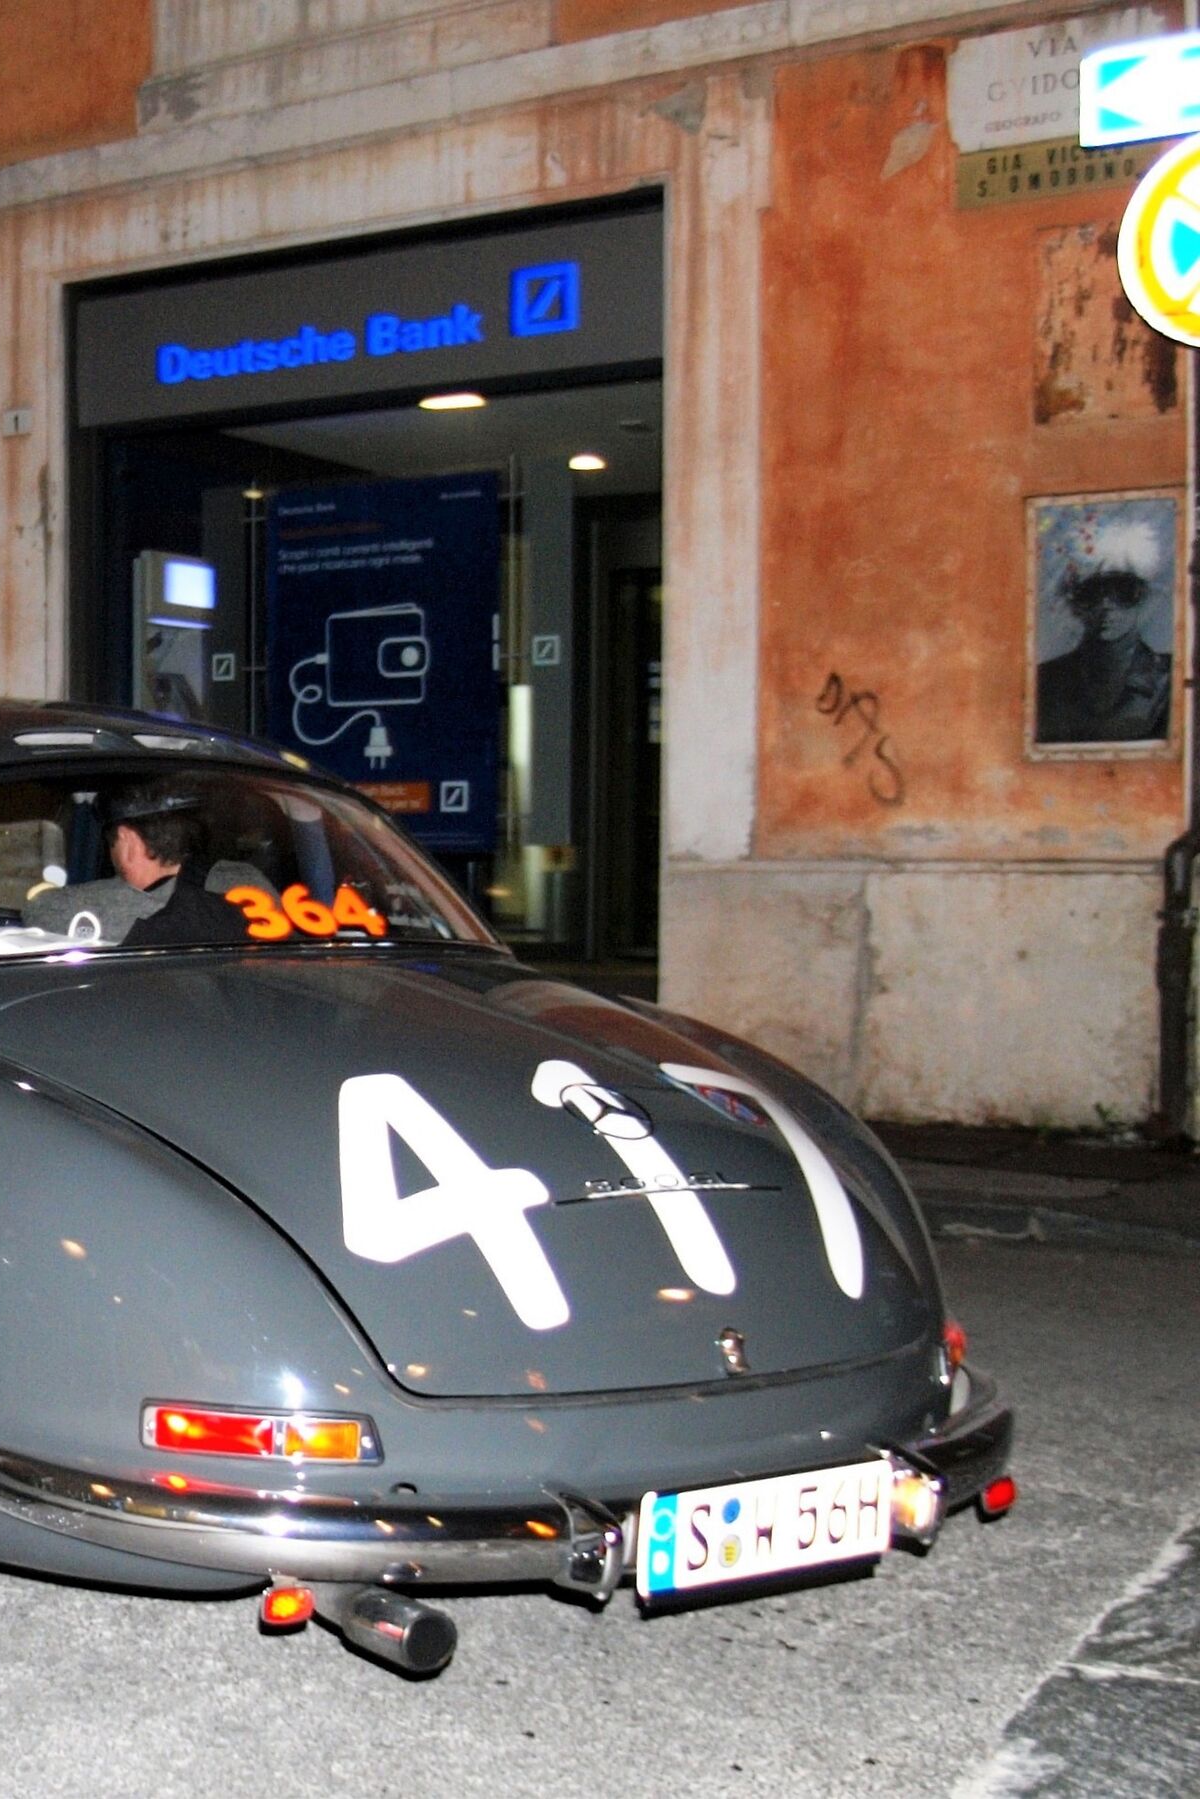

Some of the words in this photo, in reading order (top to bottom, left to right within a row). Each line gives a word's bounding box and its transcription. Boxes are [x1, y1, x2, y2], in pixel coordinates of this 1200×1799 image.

[1027, 36, 1077, 58] VIA
[156, 325, 357, 385] Deutsche
[365, 303, 485, 357] Bank
[225, 883, 387, 940] 364
[338, 1059, 864, 1331] 417
[687, 1503, 712, 1571] S
